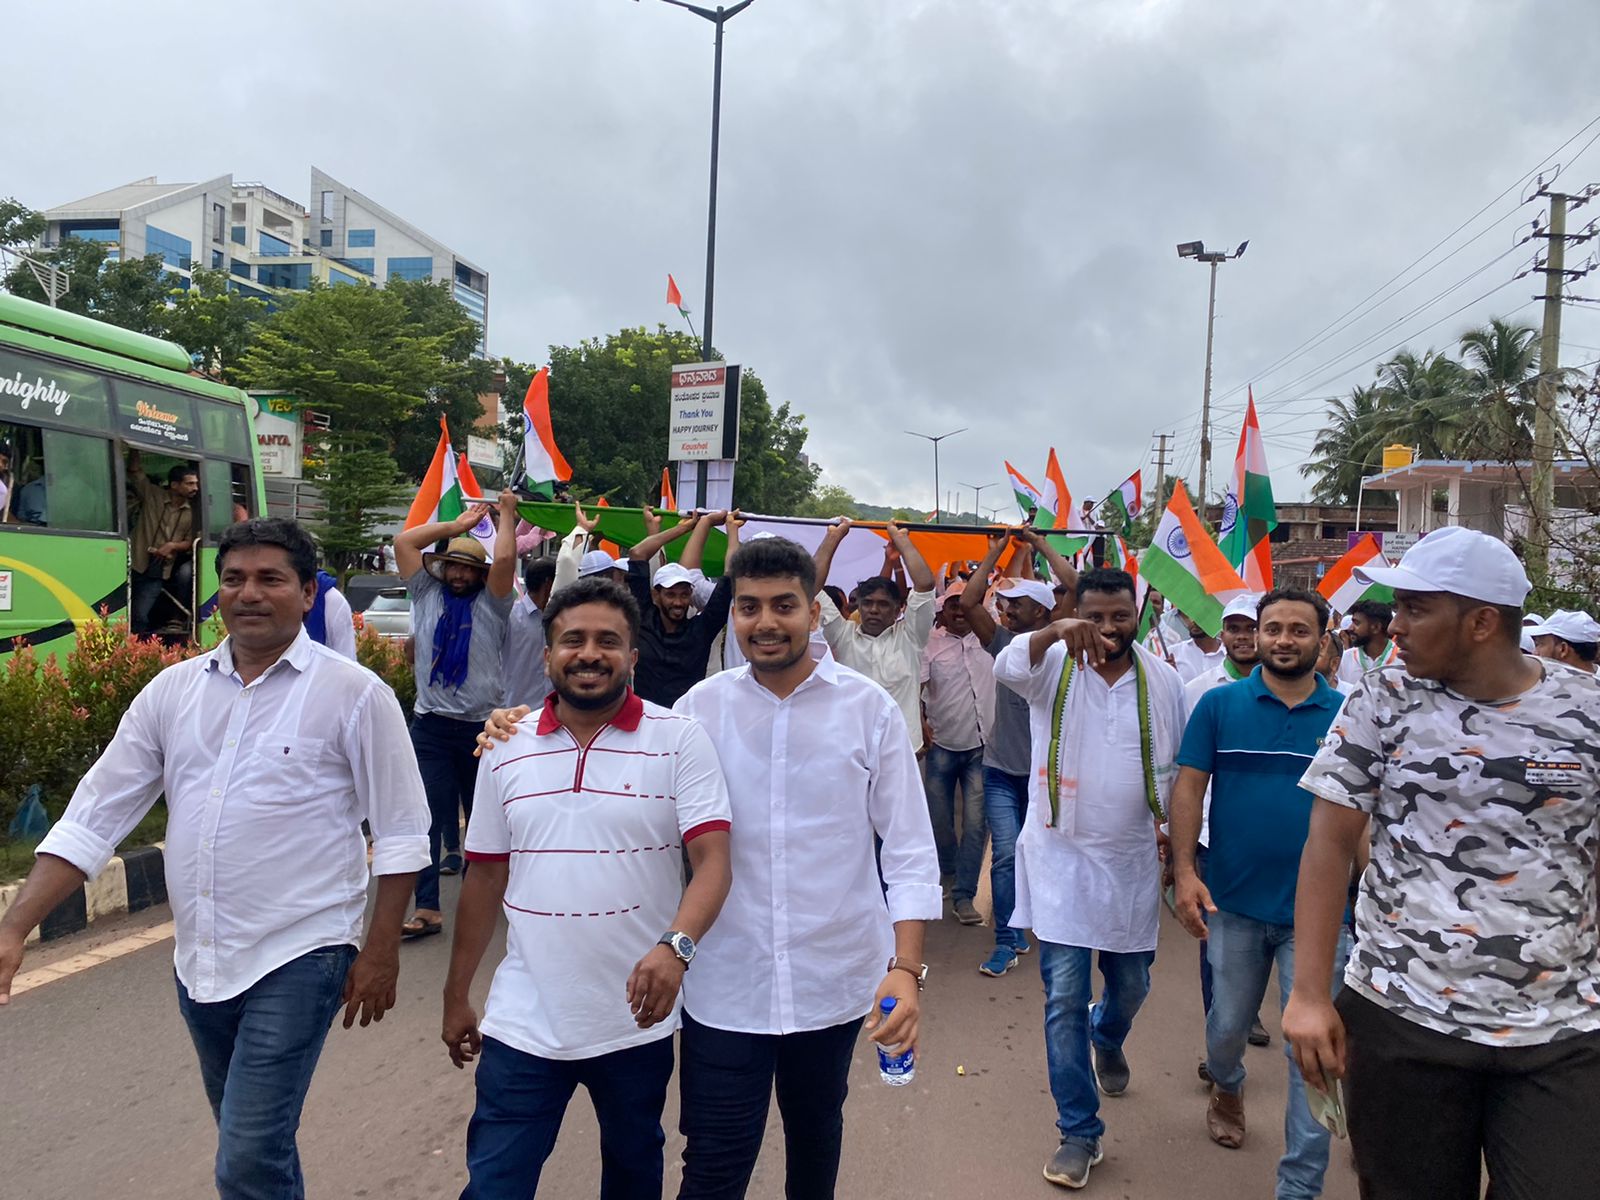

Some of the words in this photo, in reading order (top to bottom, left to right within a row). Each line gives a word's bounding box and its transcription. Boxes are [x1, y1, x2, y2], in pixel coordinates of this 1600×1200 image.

[679, 370, 716, 385] ಧನ್ಯವಾದ
[136, 400, 178, 423] Welcome
[679, 408, 700, 419] Thank
[701, 408, 714, 418] You
[672, 425, 692, 434] HAPPY
[692, 424, 719, 434] JOURNEY
